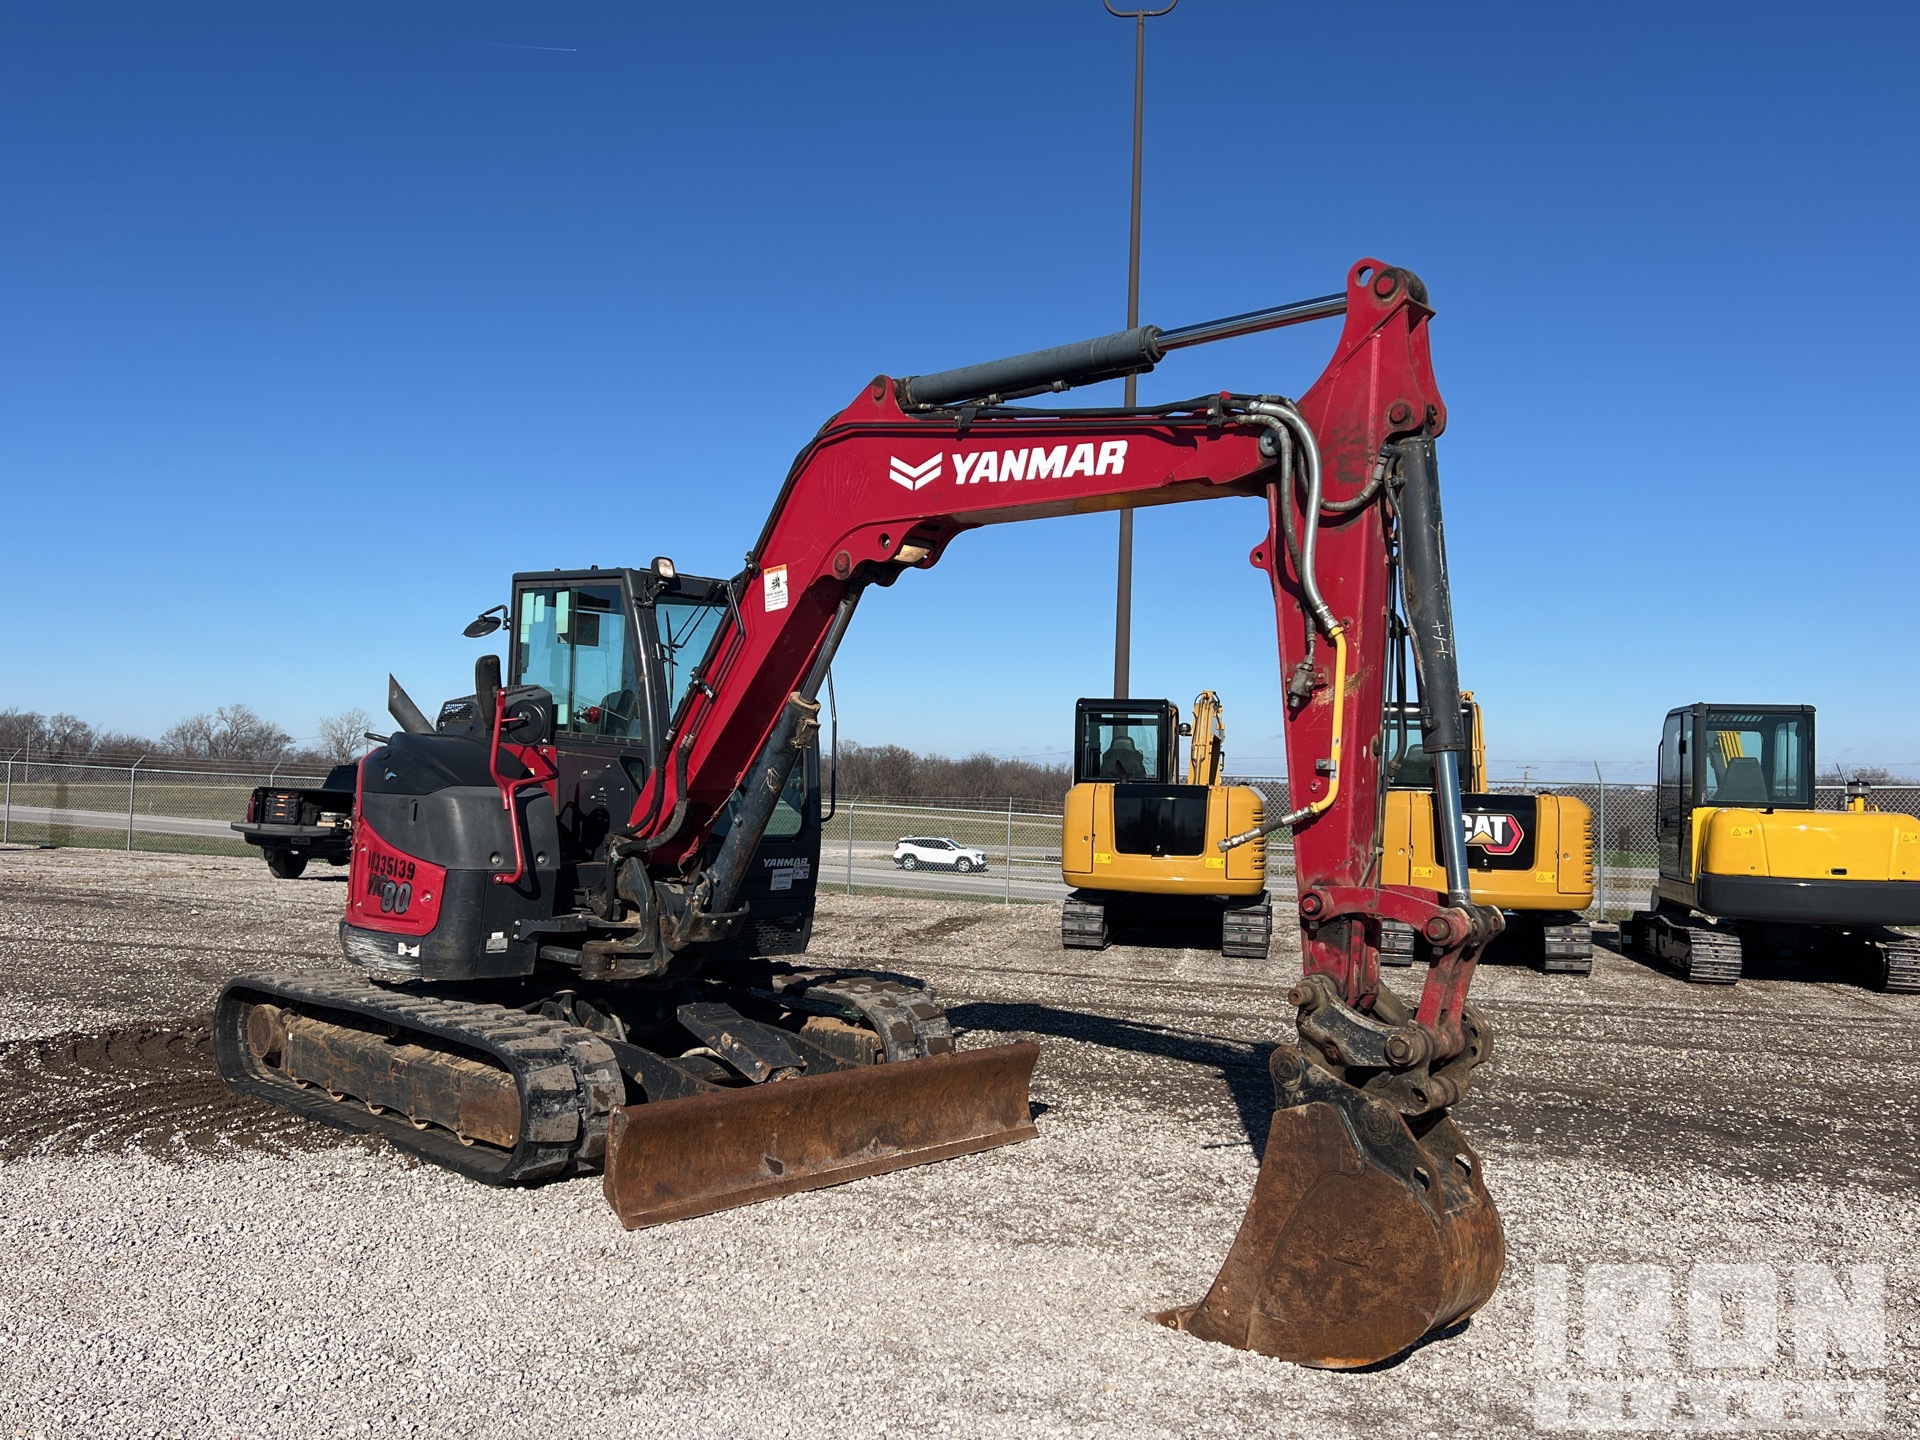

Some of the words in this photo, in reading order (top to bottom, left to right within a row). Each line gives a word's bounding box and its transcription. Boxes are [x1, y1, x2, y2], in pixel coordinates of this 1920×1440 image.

[952, 440, 1128, 485] YANMAR
[1461, 815, 1507, 844] CAT
[368, 851, 416, 880] 10335139
[763, 857, 808, 867] YANMAR
